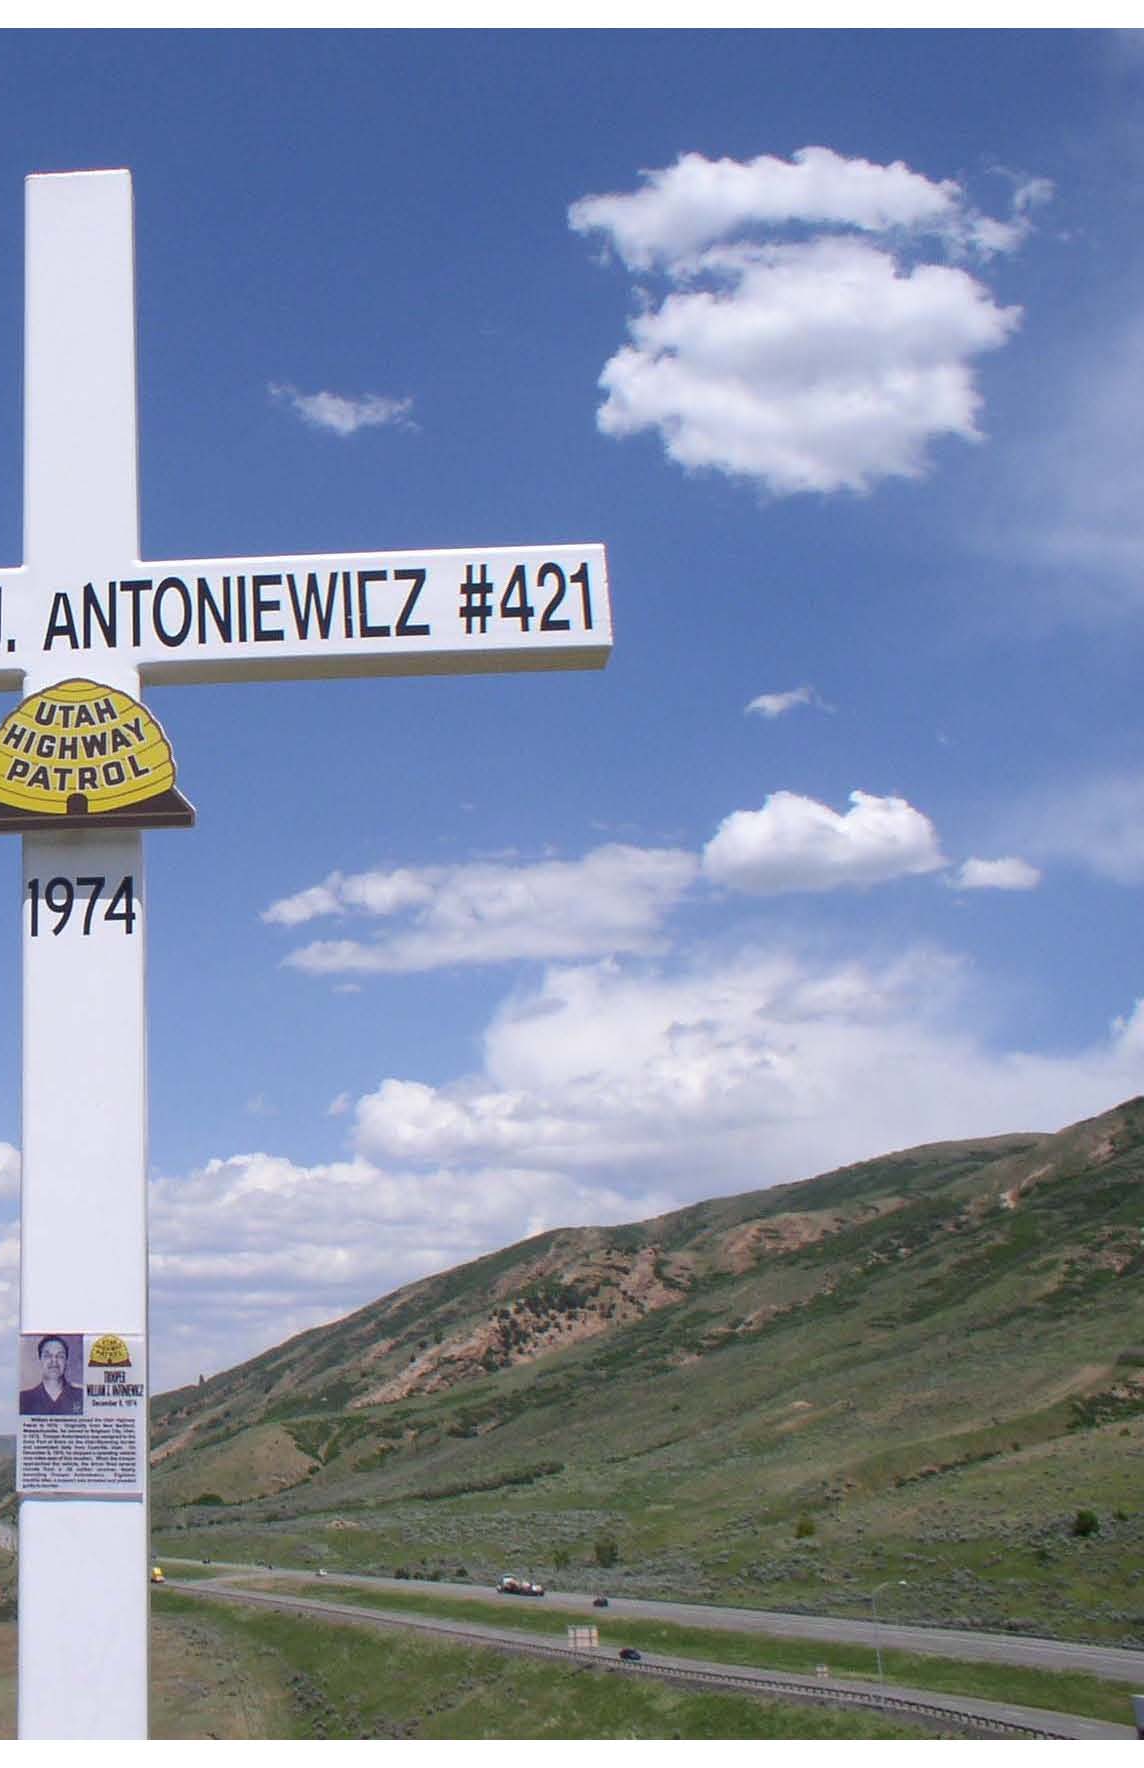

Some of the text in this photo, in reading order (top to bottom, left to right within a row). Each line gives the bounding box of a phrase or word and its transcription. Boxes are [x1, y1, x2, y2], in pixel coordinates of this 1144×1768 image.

[43, 568, 430, 651] ANTONIEWICZ
[459, 562, 593, 634] #421
[35, 698, 118, 728] UTAH
[3, 718, 145, 760] HIGHWAY
[7, 755, 149, 791] PATROL
[28, 876, 136, 937] 1974
